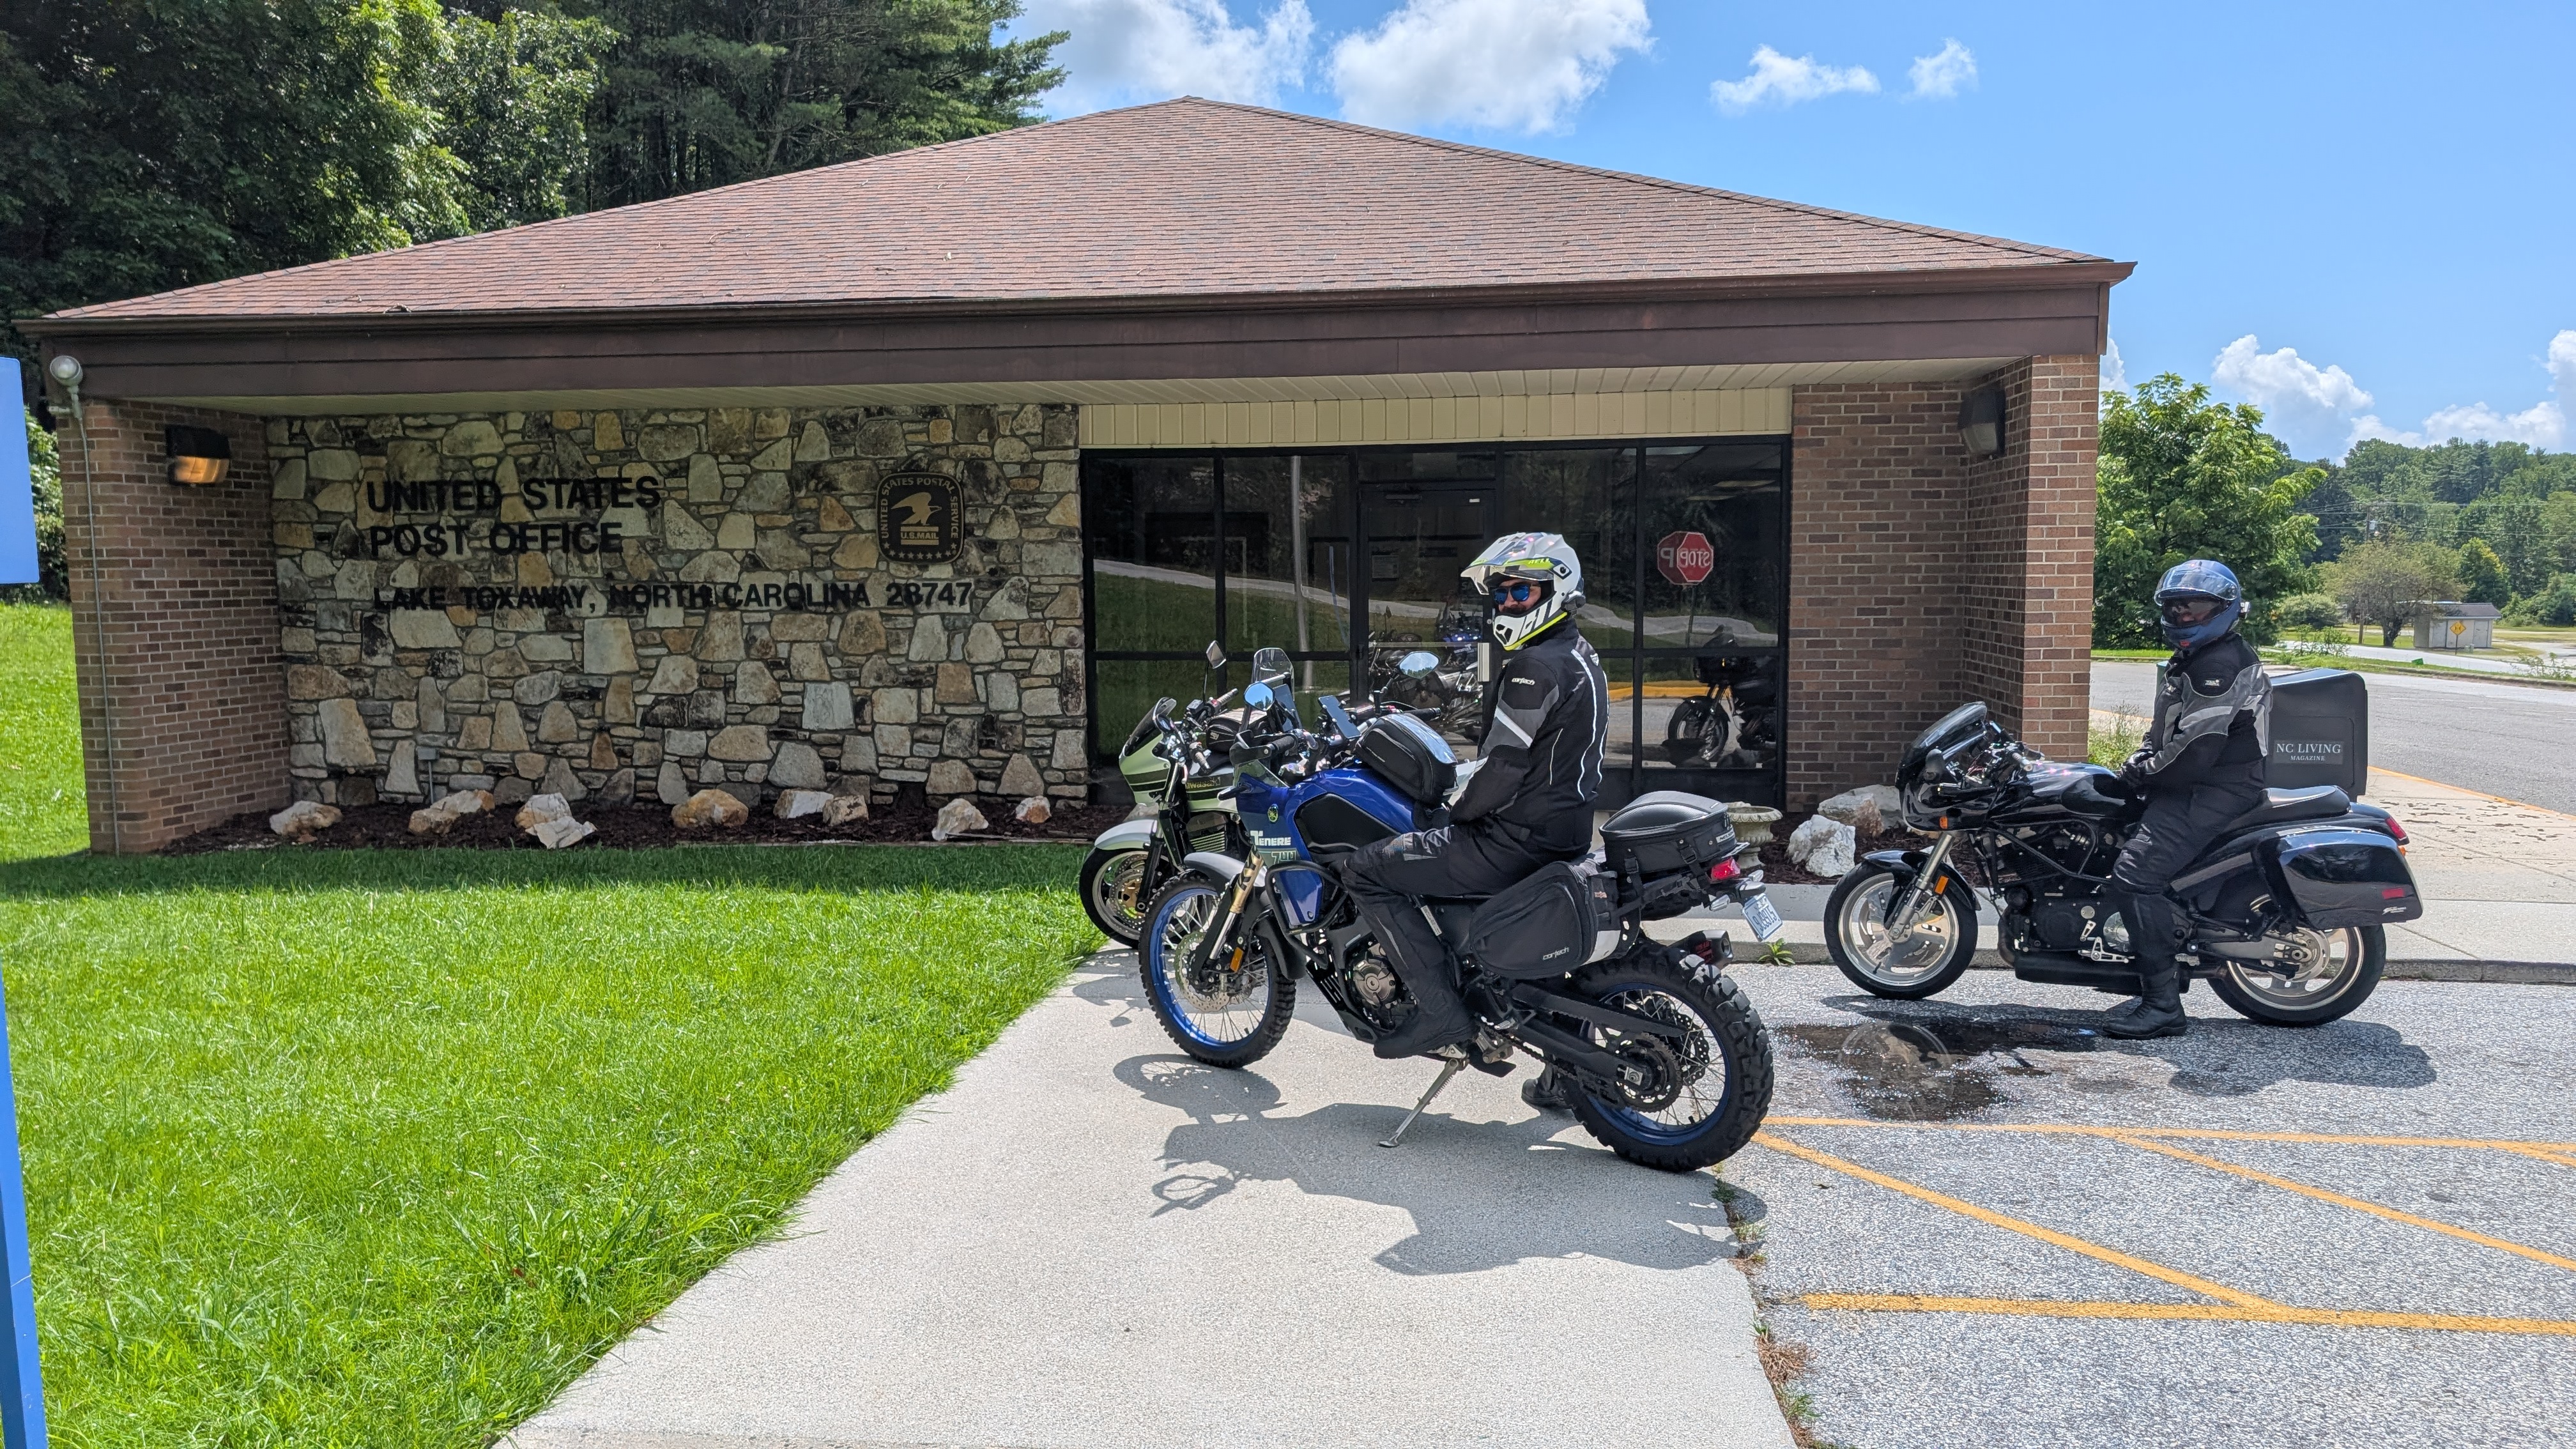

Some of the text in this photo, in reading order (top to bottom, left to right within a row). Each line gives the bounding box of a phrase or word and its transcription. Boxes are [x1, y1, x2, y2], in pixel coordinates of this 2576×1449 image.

[367, 476, 661, 512] UNITED STATES
[882, 477, 956, 496] STATES POSTAL
[880, 498, 889, 539] UNITED
[950, 496, 959, 539] SERVICE
[371, 522, 624, 556] POST OFFICE
[374, 581, 972, 613] LAKE TOXAWAY, NORTH CAROLINA 28747
[2276, 744, 2341, 753] NC LIVING
